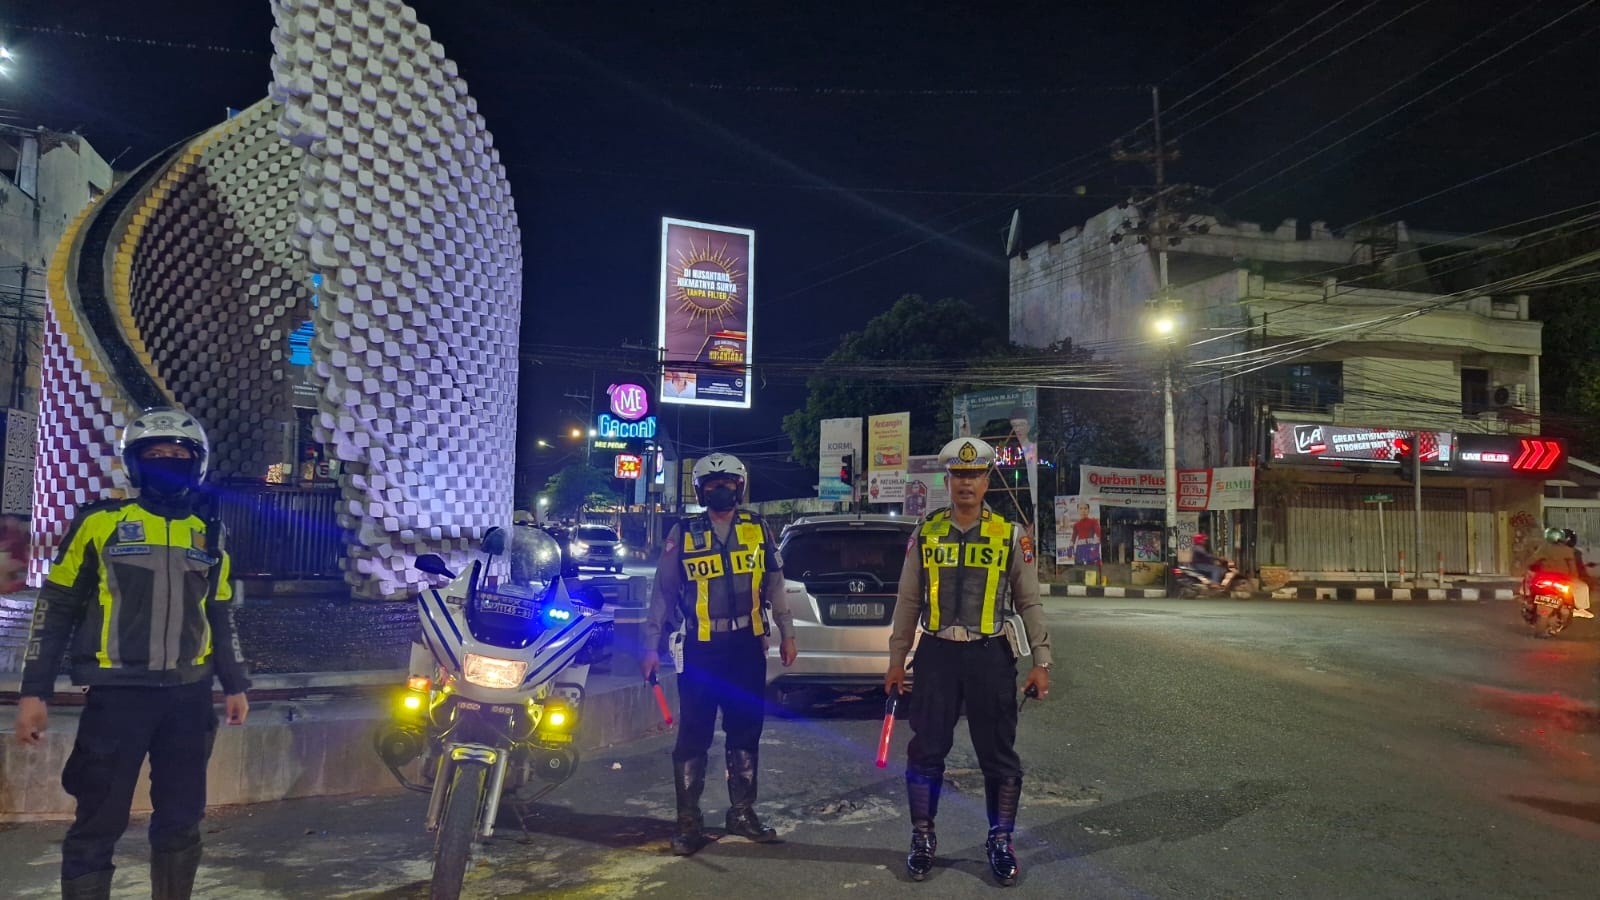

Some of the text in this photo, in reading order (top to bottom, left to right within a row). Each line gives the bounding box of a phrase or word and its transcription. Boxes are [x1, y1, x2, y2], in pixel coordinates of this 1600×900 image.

[716, 282, 737, 293] SURYA
[687, 288, 727, 300] TANPA FILTER
[622, 462, 635, 471] 24
[619, 470, 638, 478] JAM
[1088, 472, 1166, 486] Qurban Plus
[847, 604, 868, 616] 1000
